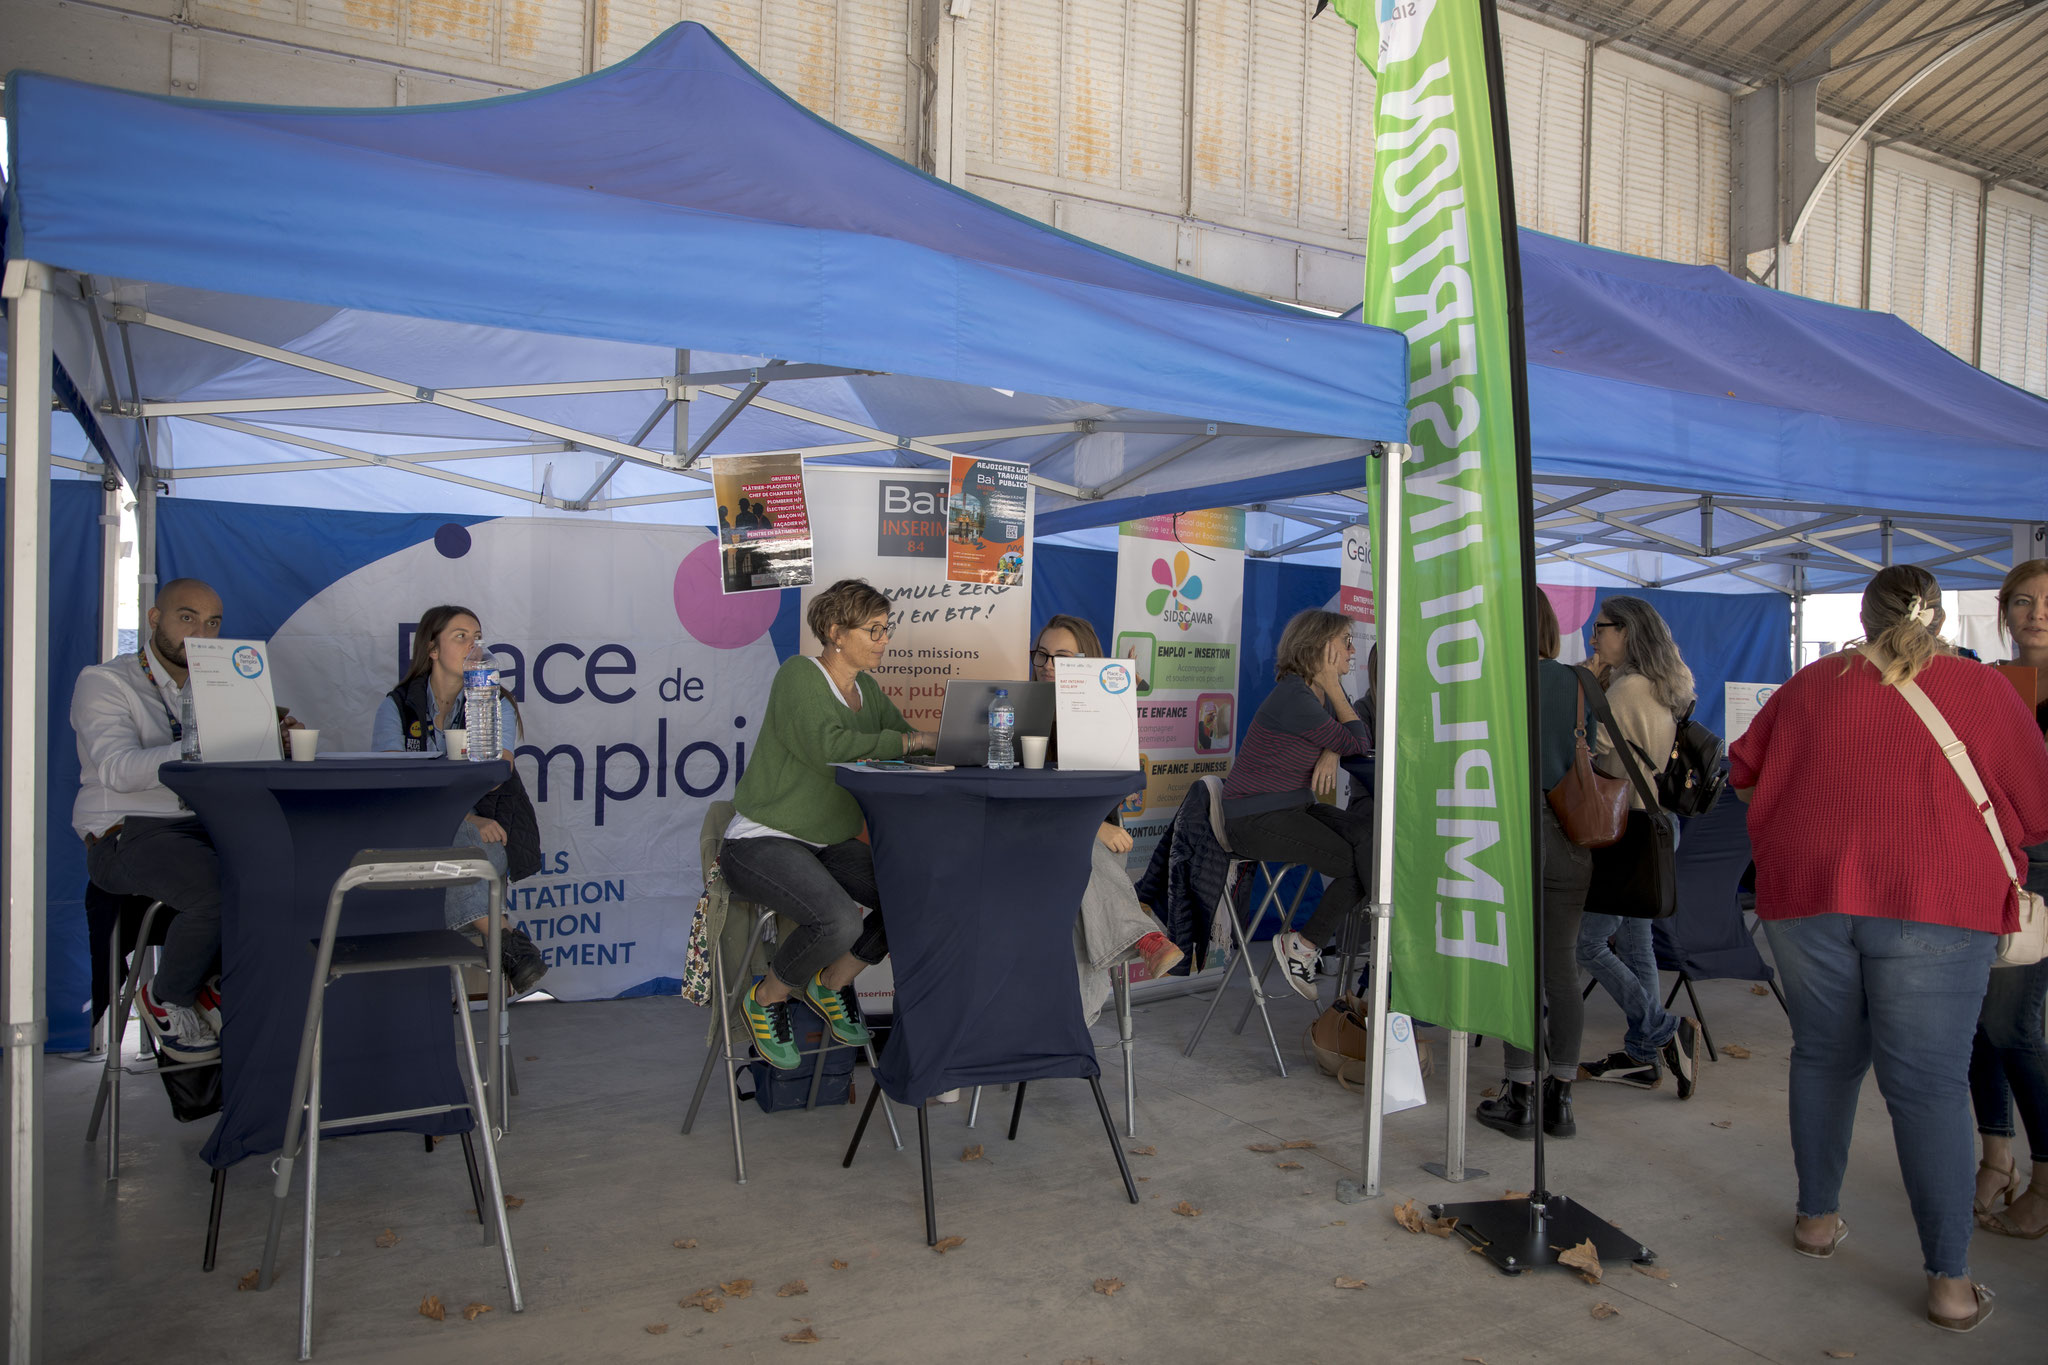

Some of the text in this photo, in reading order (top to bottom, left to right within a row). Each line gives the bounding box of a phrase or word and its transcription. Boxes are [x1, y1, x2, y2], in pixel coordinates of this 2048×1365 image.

[977, 462, 1015, 473] REJOIGNEZ
[997, 472, 1028, 481] TRAVAUX
[998, 479, 1028, 489] PUBLICS
[767, 497, 793, 505] PLOMBERIE
[777, 512, 797, 520] MAÇON
[1171, 528, 1194, 538] Aignon
[907, 540, 925, 552] 84
[882, 583, 952, 602] RMULE
[910, 609, 939, 624] EN
[945, 605, 981, 623] BTP
[1163, 609, 1213, 625] SIDSCAVAR
[888, 647, 979, 660] nos missions
[1157, 646, 1186, 658] EMPLOI
[1194, 647, 1231, 659] INSERTION
[1177, 664, 1216, 674] Accompagner
[658, 667, 704, 702] de
[910, 683, 945, 700] pub
[902, 708, 942, 719] uvre
[1151, 707, 1188, 718] ENFANCE
[1138, 724, 1174, 734] ccompagner
[1166, 736, 1176, 744] pas
[513, 716, 747, 827] mploi
[1152, 761, 1227, 775] ENFANCE JEUNESSE
[1125, 825, 1169, 838] RONTOLOG
[507, 879, 625, 911] NTATION
[515, 912, 601, 941] ATION
[857, 990, 896, 998] nserim
